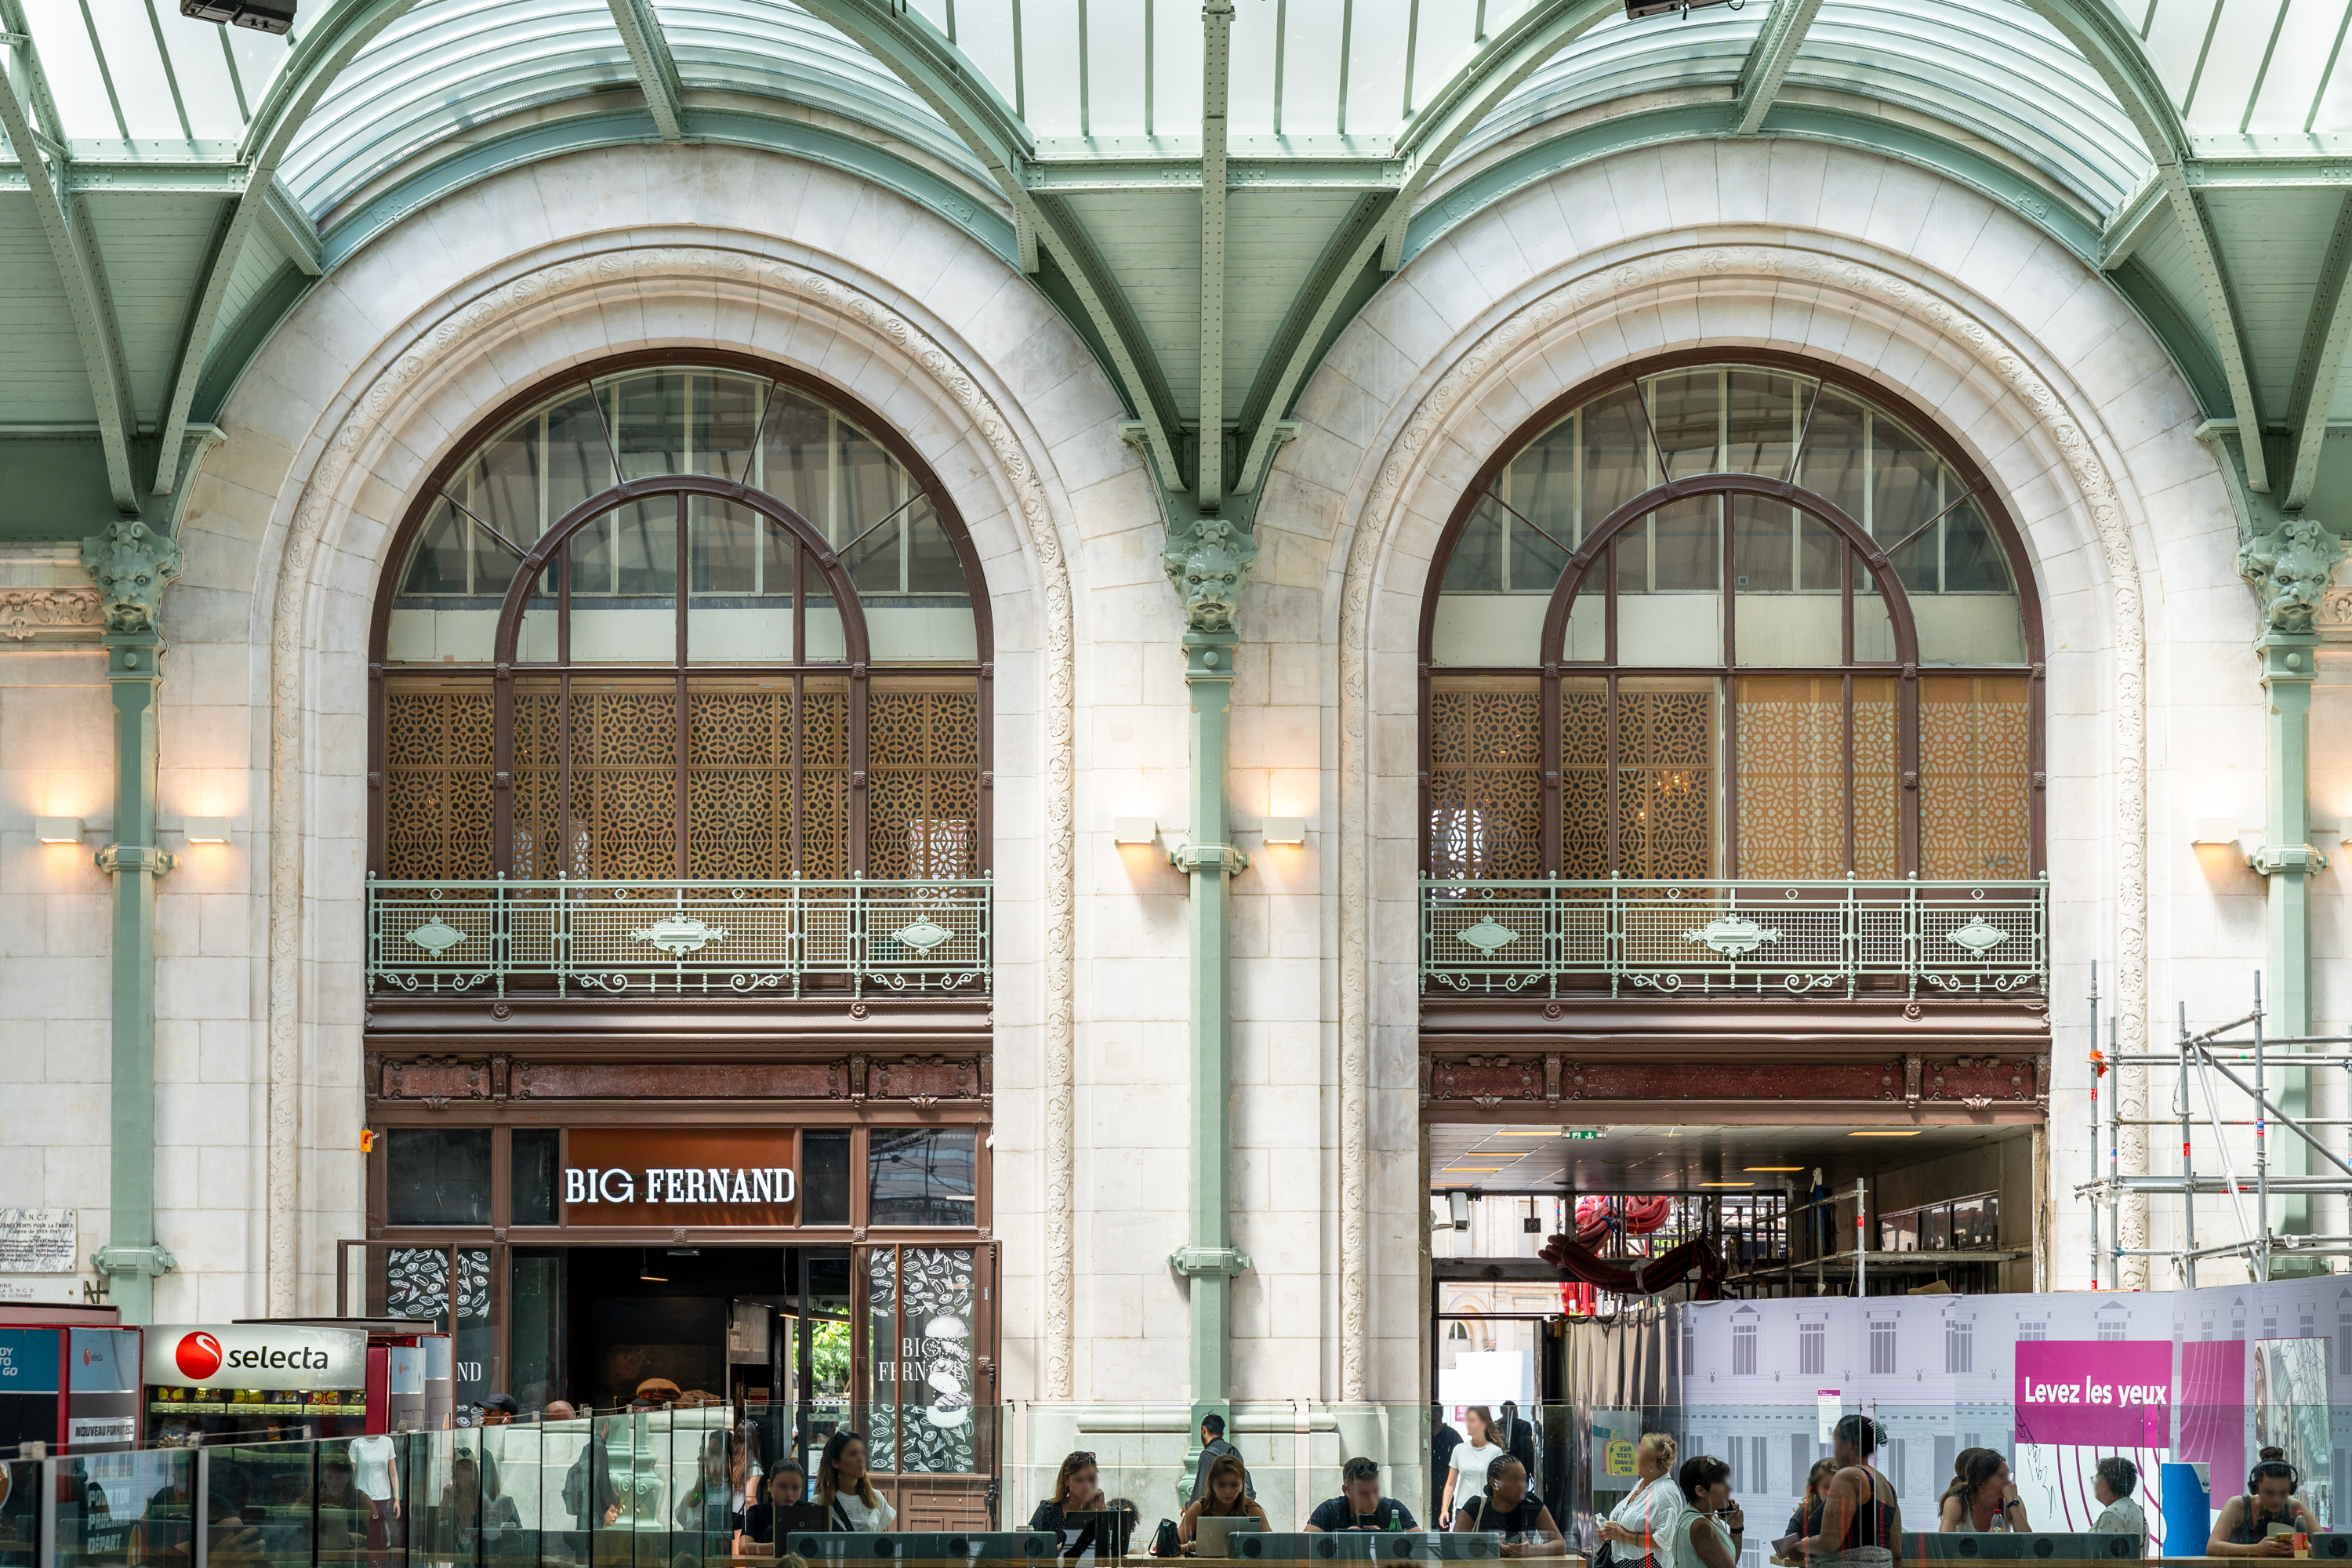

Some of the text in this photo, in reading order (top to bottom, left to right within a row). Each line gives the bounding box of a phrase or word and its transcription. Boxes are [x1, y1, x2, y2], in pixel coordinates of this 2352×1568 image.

[564, 1168, 795, 1203] BIG FERNAND
[227, 1345, 328, 1370] selecta
[902, 1338, 942, 1358] BIG
[2, 1367, 18, 1377] GO
[2024, 1375, 2168, 1408] Levez les yeux
[74, 1425, 107, 1437] NOUVEAU
[107, 1425, 125, 1436] FORMAT
[88, 1488, 113, 1507] POUR
[87, 1509, 131, 1531] PROCHAIN
[87, 1533, 122, 1555] DÉPART
